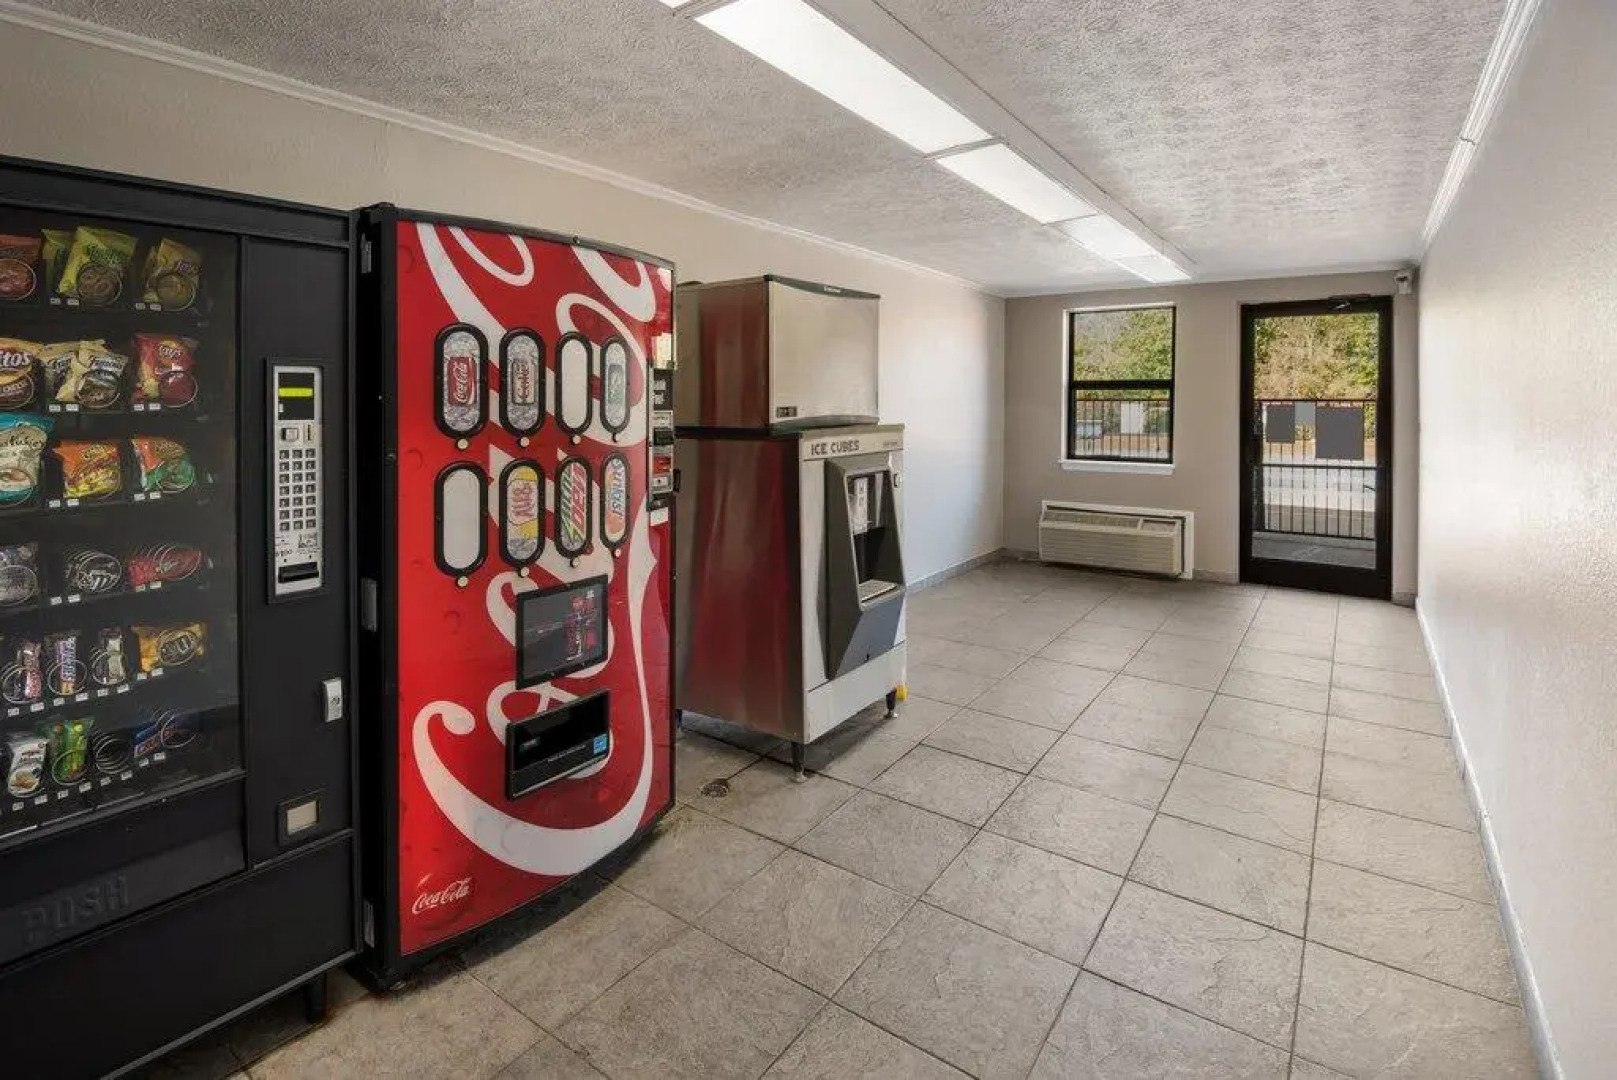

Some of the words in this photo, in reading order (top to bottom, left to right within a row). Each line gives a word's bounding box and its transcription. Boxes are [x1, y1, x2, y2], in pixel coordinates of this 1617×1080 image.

[811, 442, 827, 456] ICE
[830, 440, 860, 454] CUBES
[21, 871, 128, 943] PUSH
[412, 877, 472, 915] Coca-Cola
